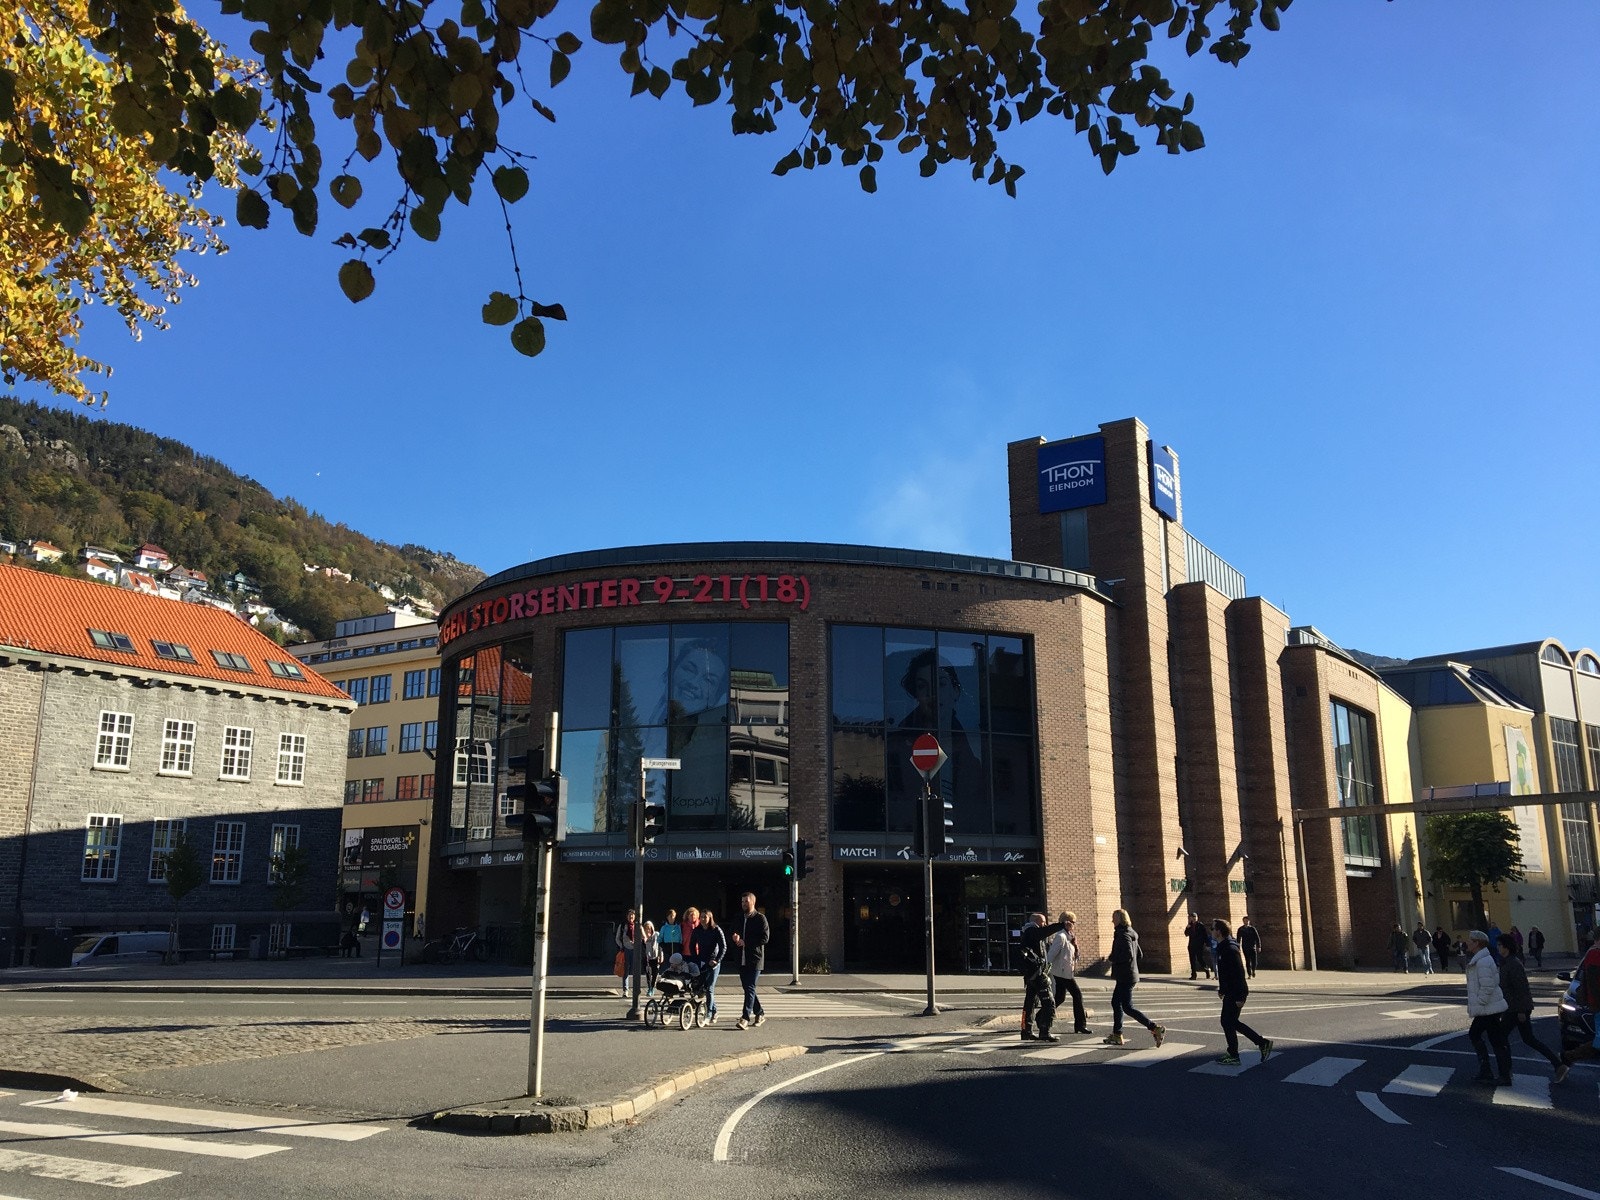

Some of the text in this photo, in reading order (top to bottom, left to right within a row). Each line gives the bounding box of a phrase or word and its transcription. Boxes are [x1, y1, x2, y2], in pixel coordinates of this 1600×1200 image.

[1041, 459, 1101, 483] THON
[1050, 478, 1094, 493] EIENDOM
[440, 608, 467, 646] GEN
[470, 578, 641, 631] STORSENTER
[672, 796, 721, 808] KappAhl
[840, 847, 877, 857] MATCH
[949, 853, 978, 862] sunkost
